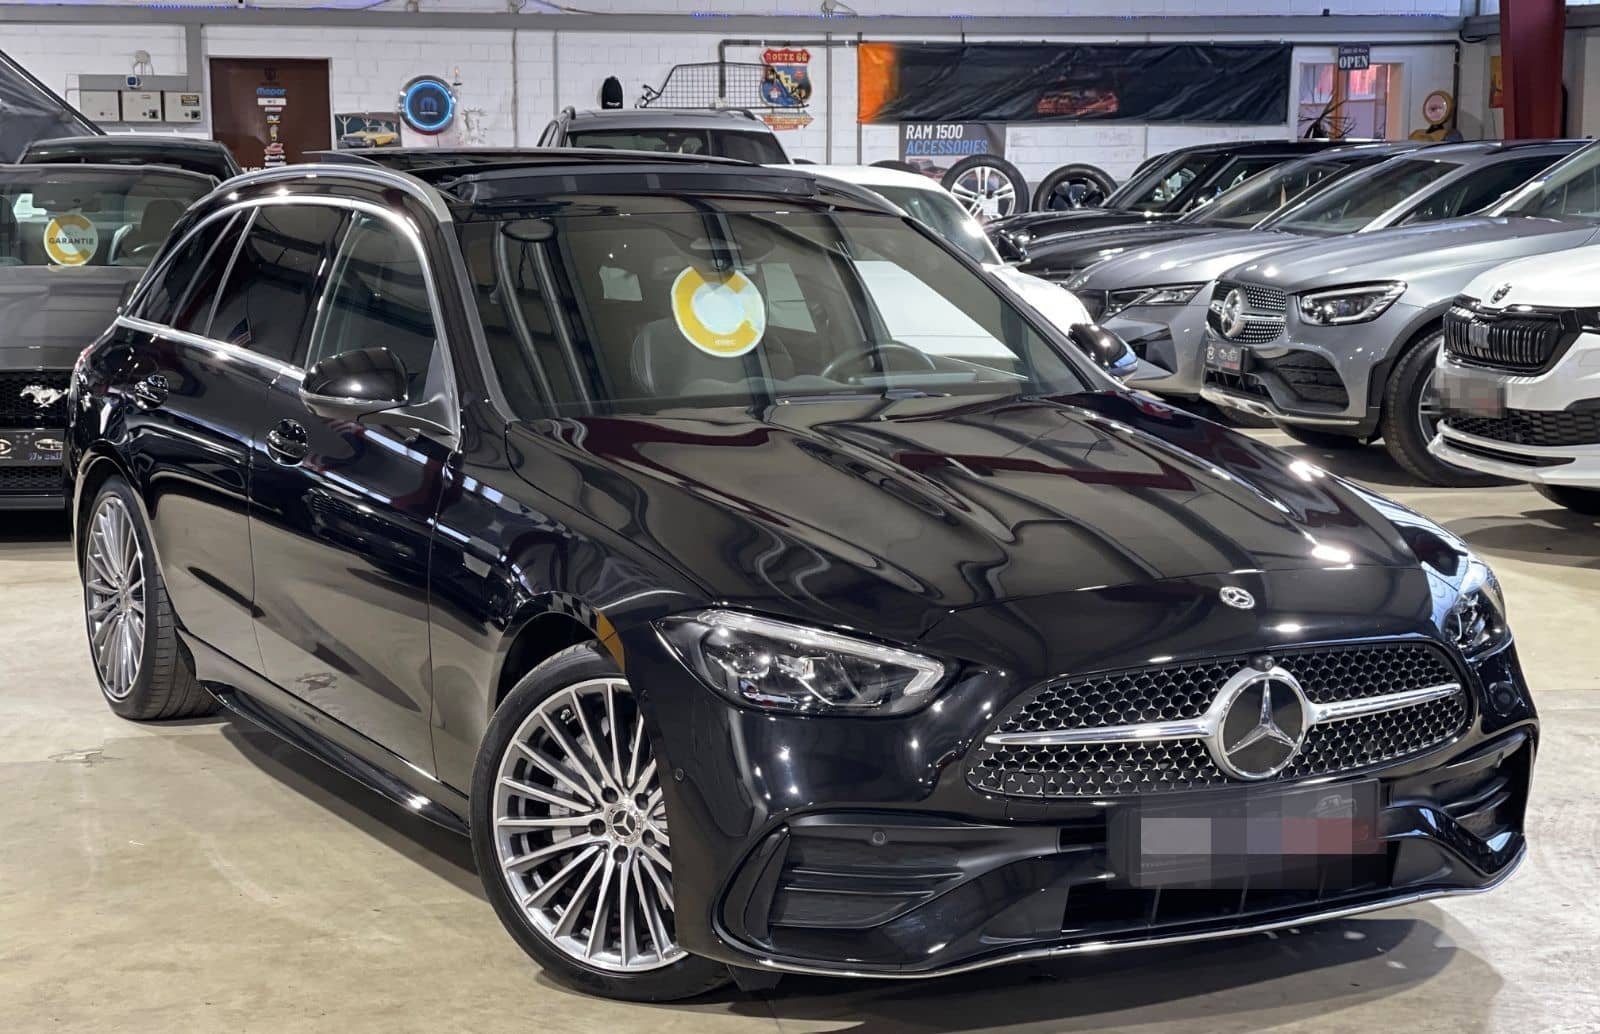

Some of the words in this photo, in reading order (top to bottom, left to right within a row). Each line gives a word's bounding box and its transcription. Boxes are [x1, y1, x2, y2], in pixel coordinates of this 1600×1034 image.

[765, 53, 794, 62] ROUTE
[796, 53, 808, 62] 66
[1339, 55, 1368, 68] OPEN
[905, 124, 932, 140] RAM
[935, 124, 964, 140] 1500
[905, 139, 988, 155] ACCESSORIES
[47, 237, 93, 245] GARANTIE
